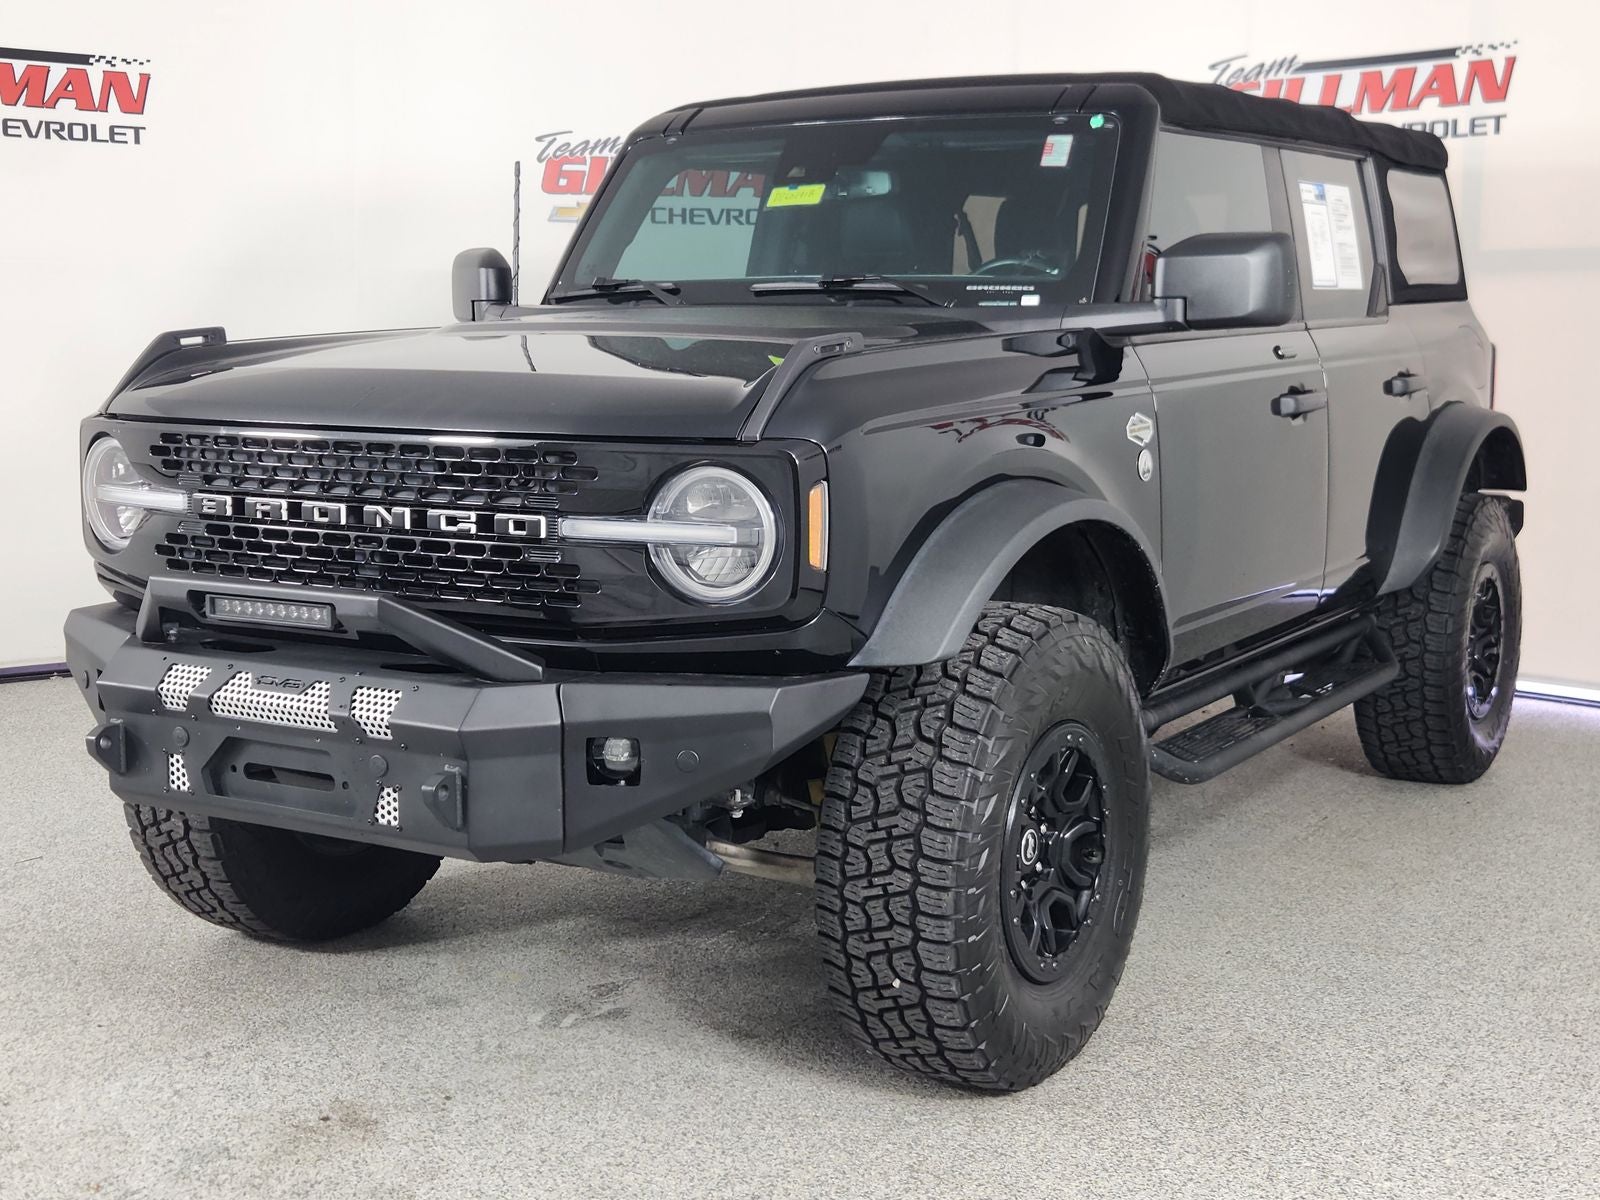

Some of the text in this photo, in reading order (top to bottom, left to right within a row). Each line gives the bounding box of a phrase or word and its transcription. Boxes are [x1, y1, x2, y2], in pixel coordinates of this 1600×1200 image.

[1208, 54, 1298, 86] Team
[1, 118, 147, 145] EVROLET
[535, 130, 622, 164] Team
[192, 492, 547, 539] BRONCO
